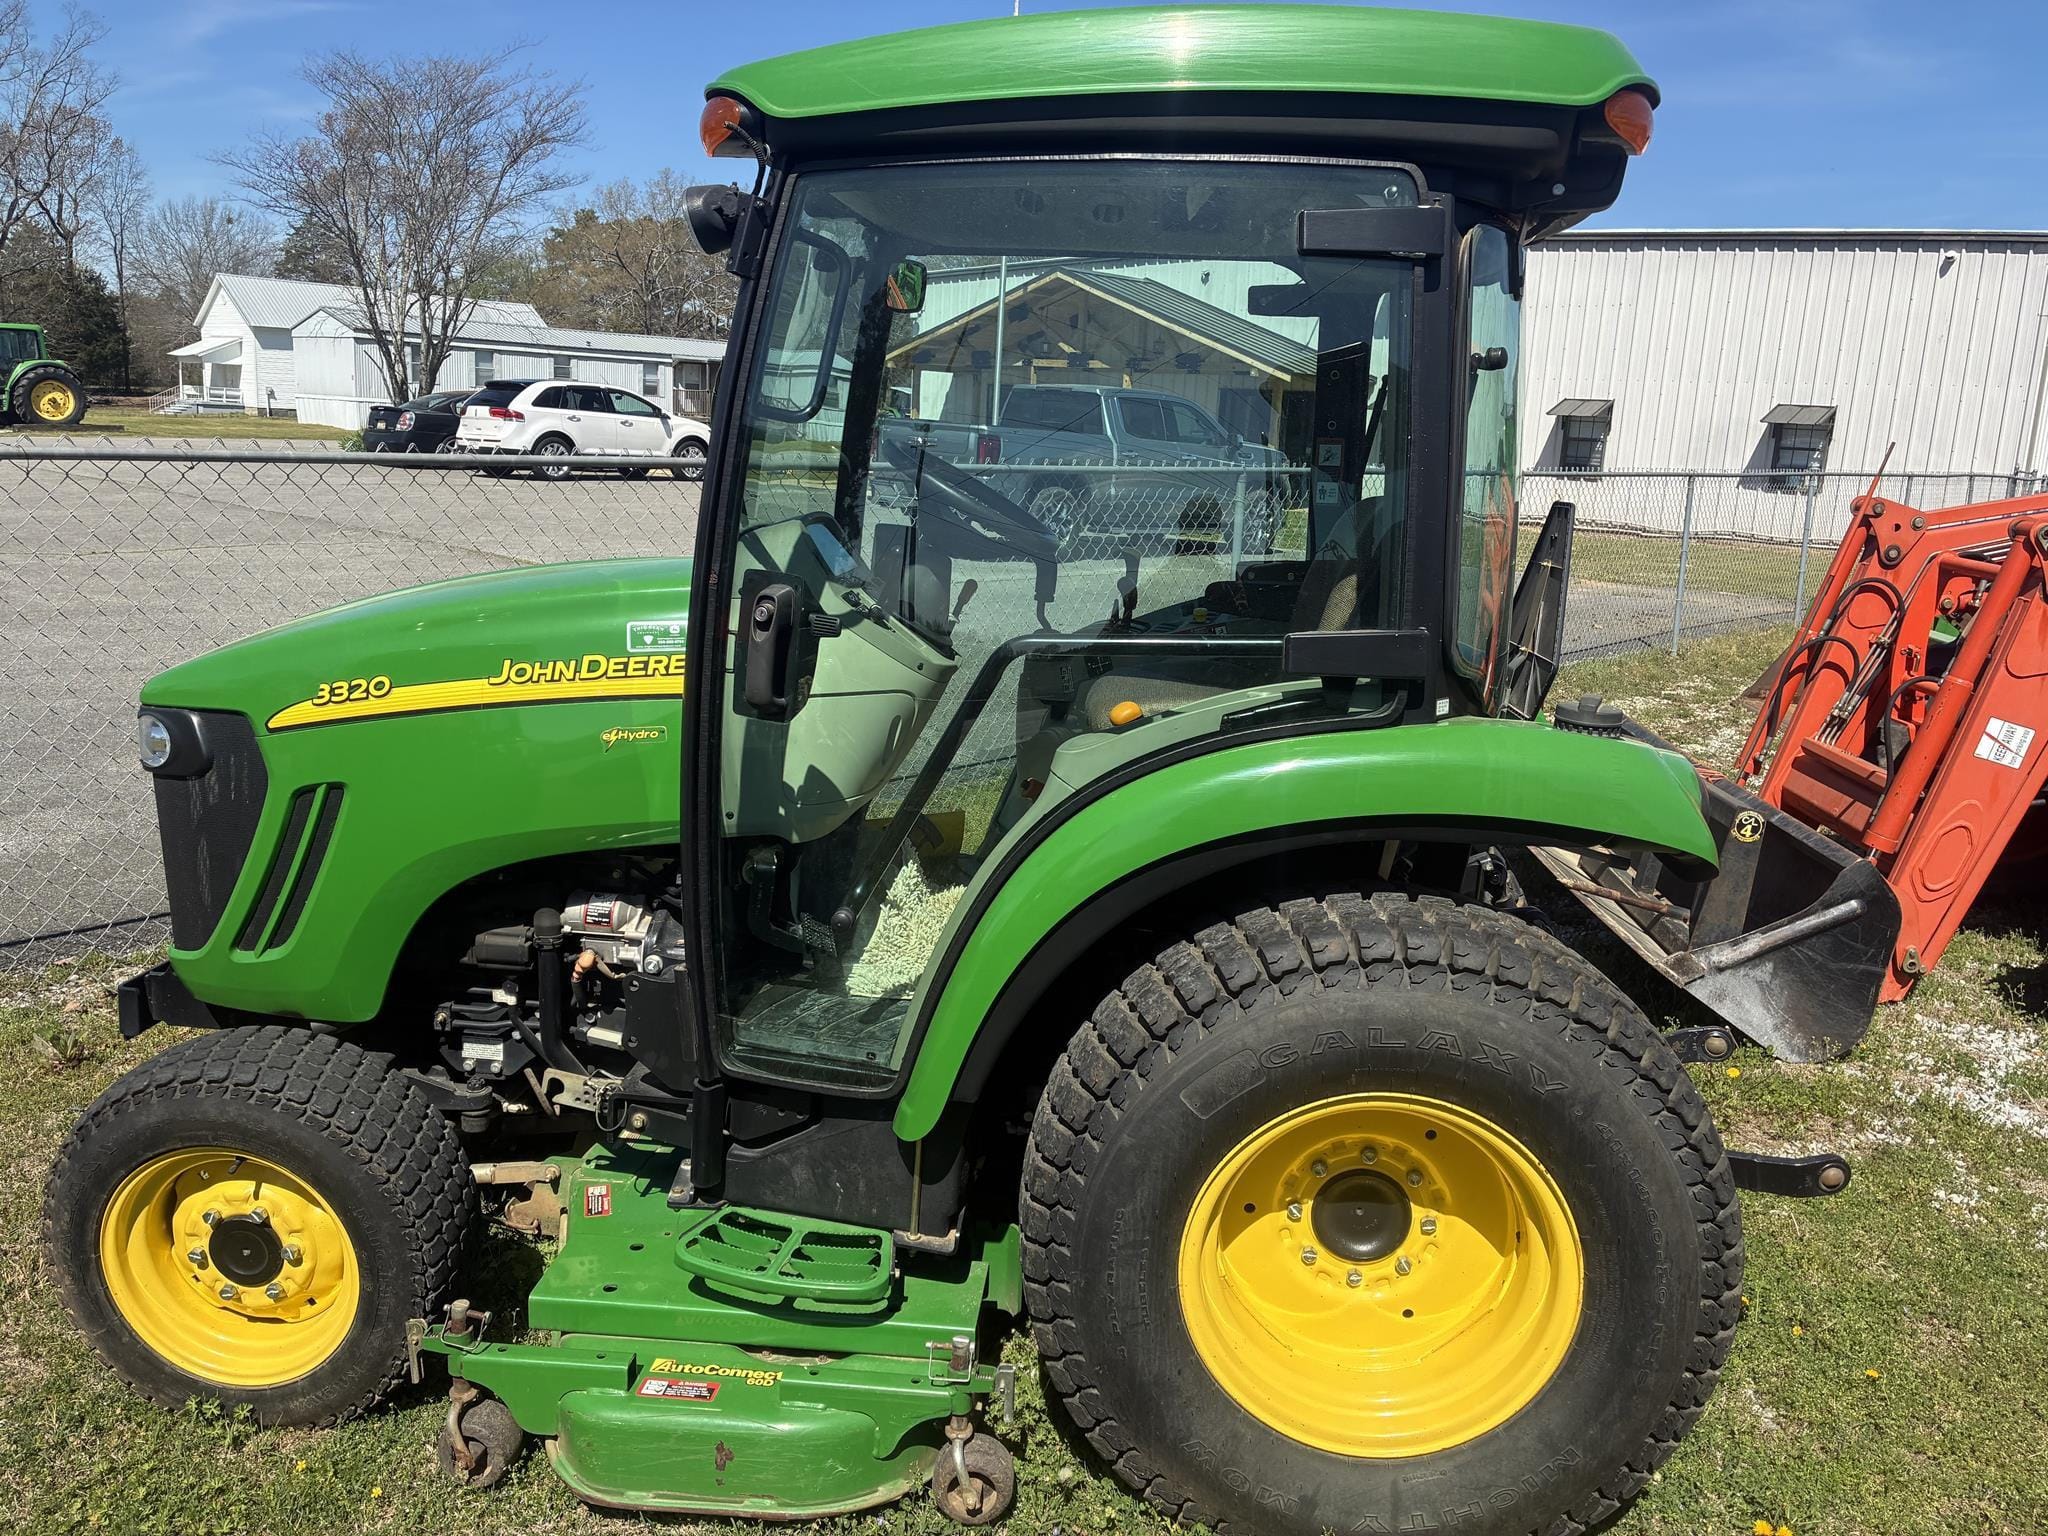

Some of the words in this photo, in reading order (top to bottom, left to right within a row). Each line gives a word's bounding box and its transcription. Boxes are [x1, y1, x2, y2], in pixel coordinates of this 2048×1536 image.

[488, 658, 578, 685] JOHN
[579, 654, 686, 680] DEERE
[312, 675, 392, 705] 3320
[1258, 1026, 1569, 1096] GALAXY
[651, 1358, 783, 1380] AutoConnect
[746, 1377, 775, 1387] 60D
[1182, 1439, 1300, 1516] MOW
[1351, 1446, 1583, 1533] MIGHTY
